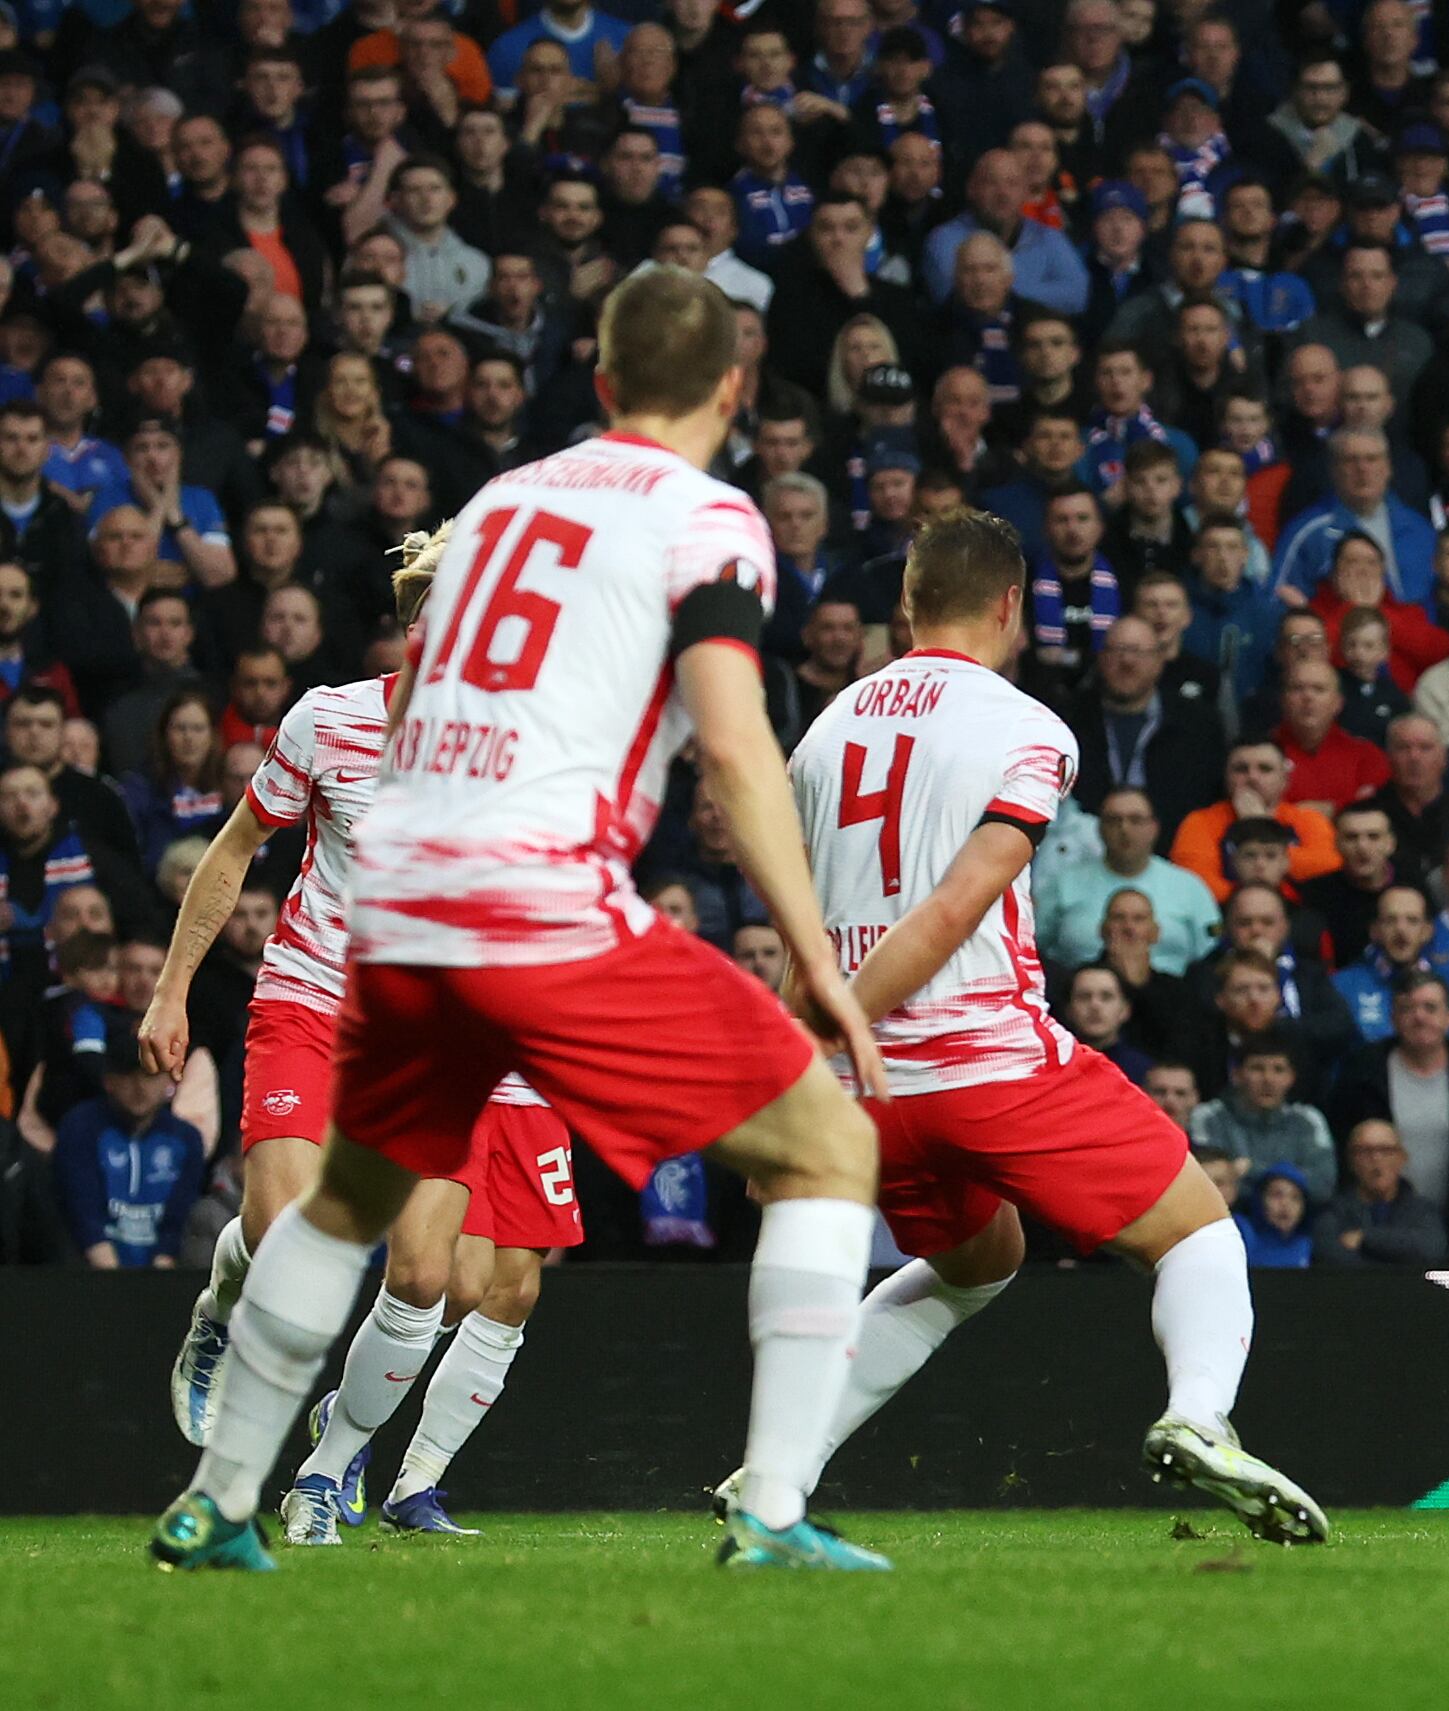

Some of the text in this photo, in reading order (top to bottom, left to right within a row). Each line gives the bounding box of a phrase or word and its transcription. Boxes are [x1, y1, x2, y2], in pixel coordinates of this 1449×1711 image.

[424, 504, 594, 692] 16
[854, 673, 947, 718] ORBÁN
[838, 733, 915, 897] 4
